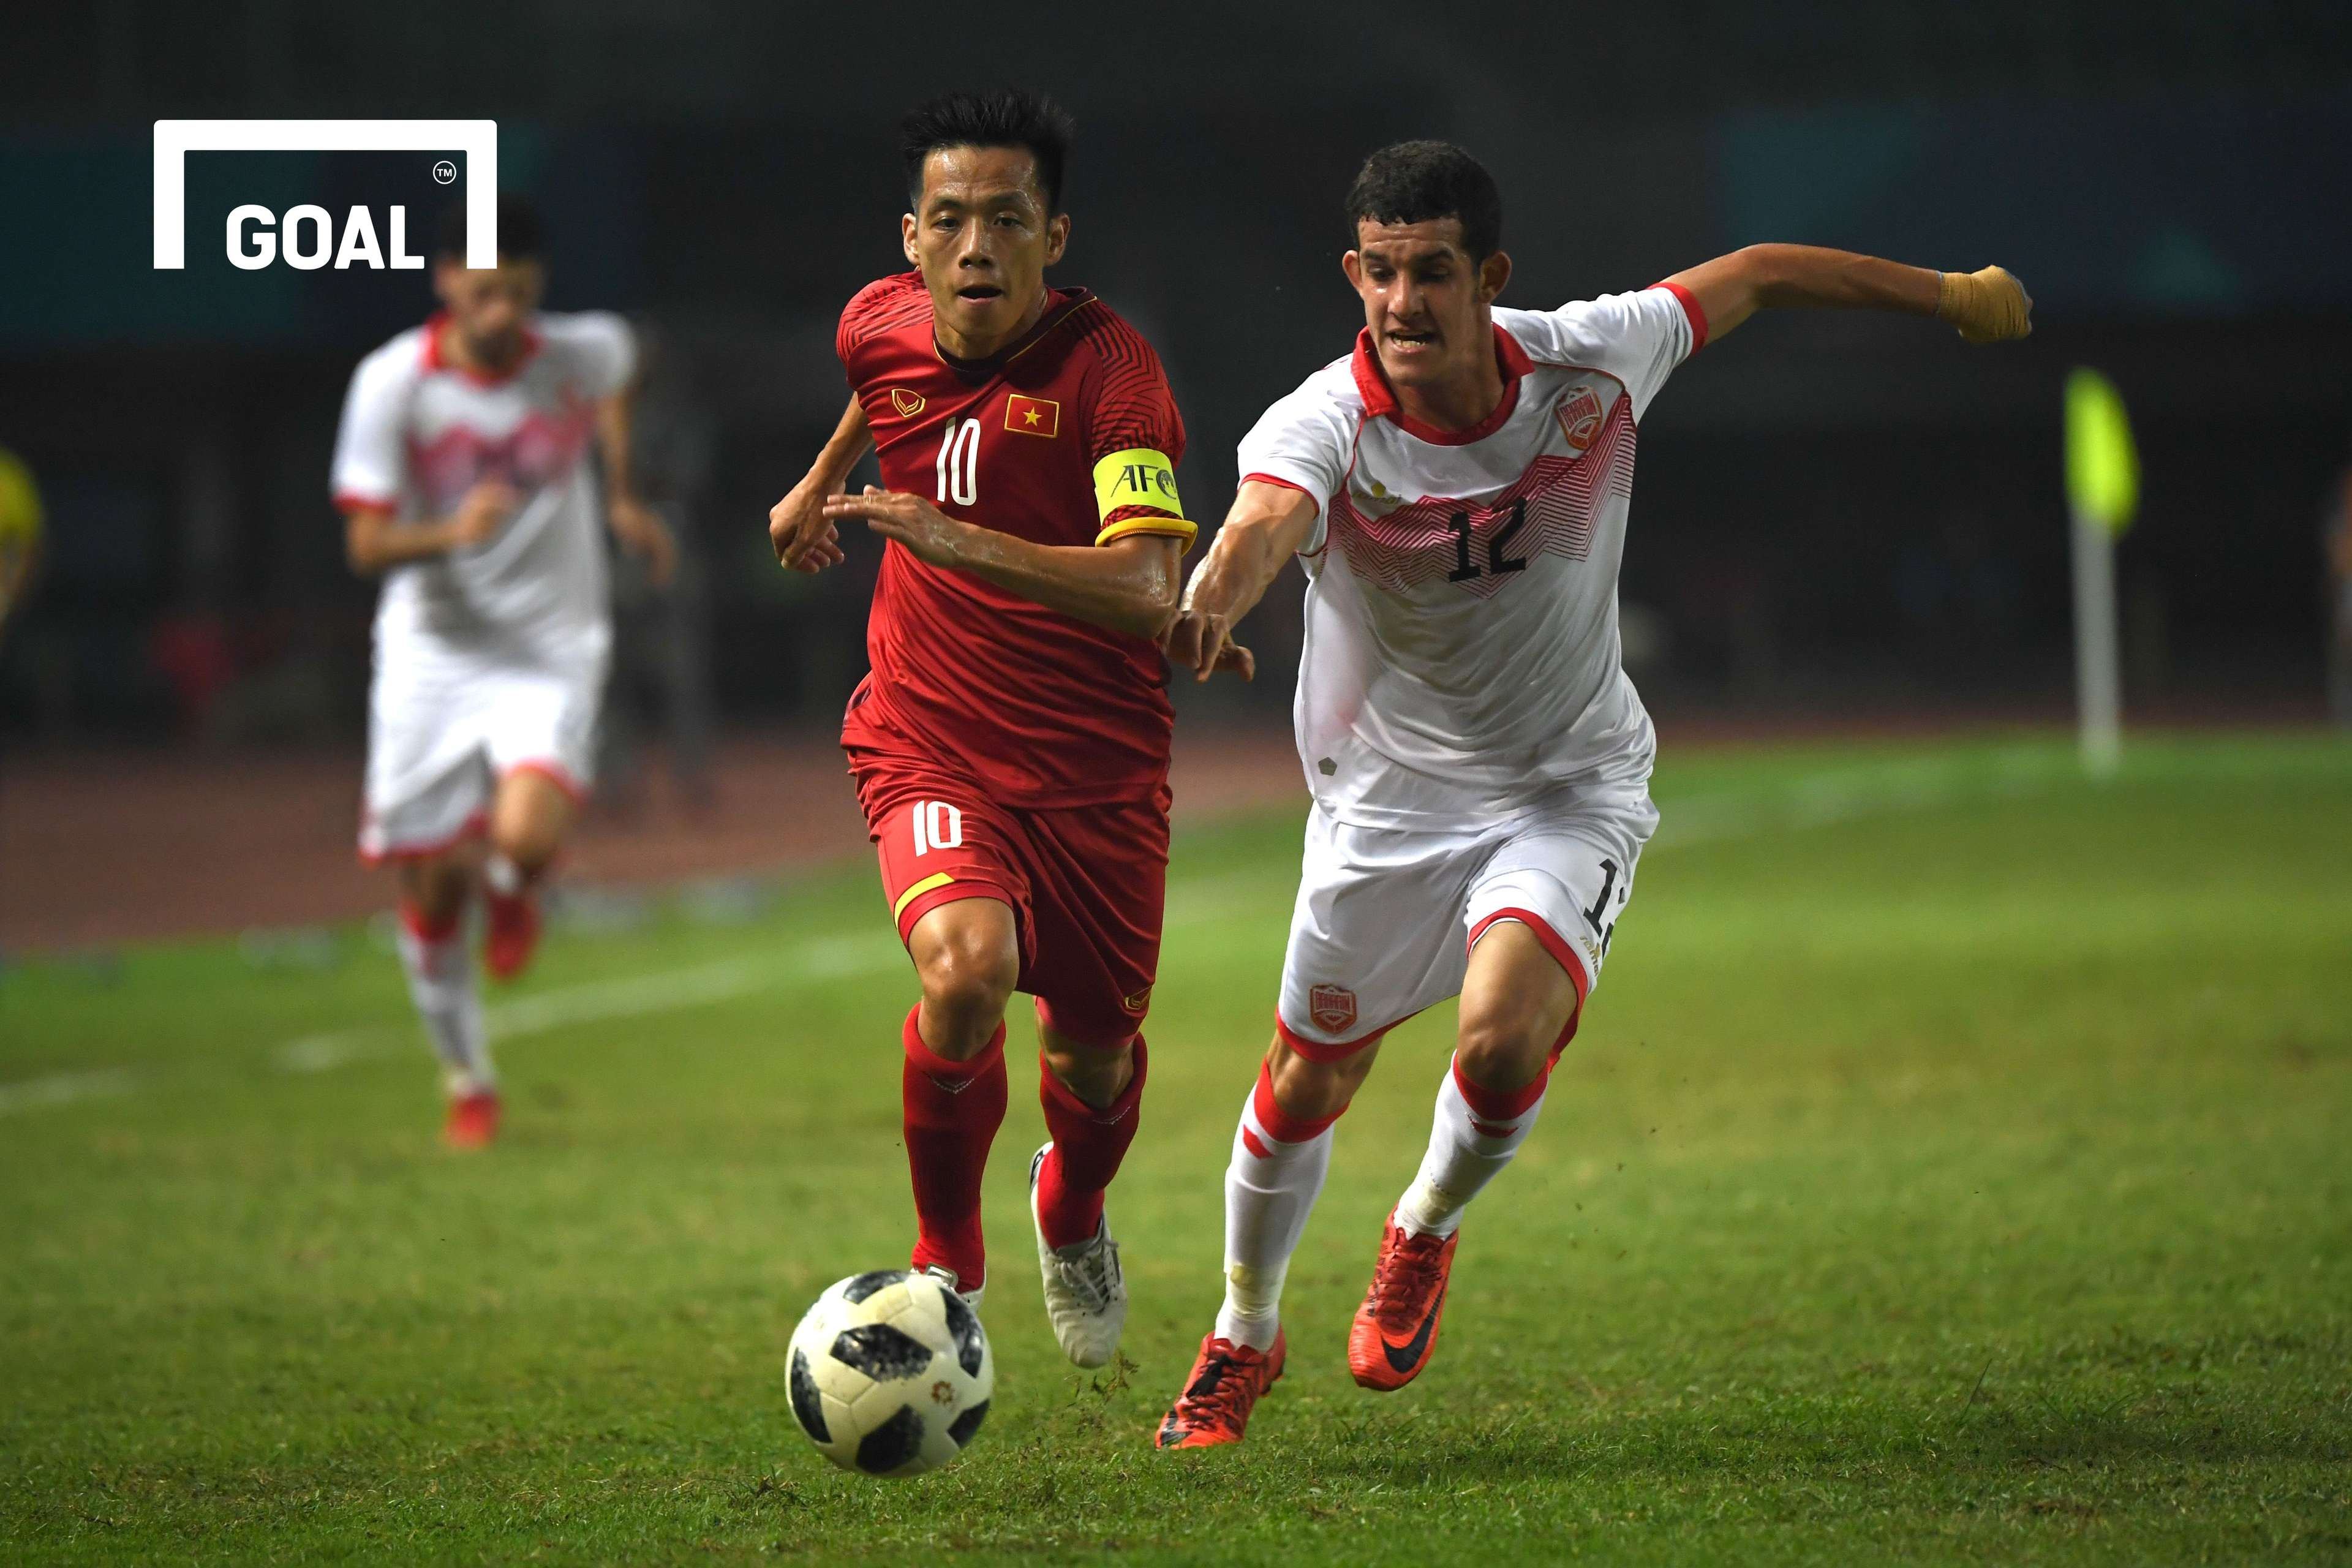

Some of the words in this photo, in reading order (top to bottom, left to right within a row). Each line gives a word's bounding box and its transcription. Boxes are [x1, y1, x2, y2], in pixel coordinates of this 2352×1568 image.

[937, 417, 981, 506] 10
[1448, 496, 1527, 582] 12
[913, 800, 962, 857] 10
